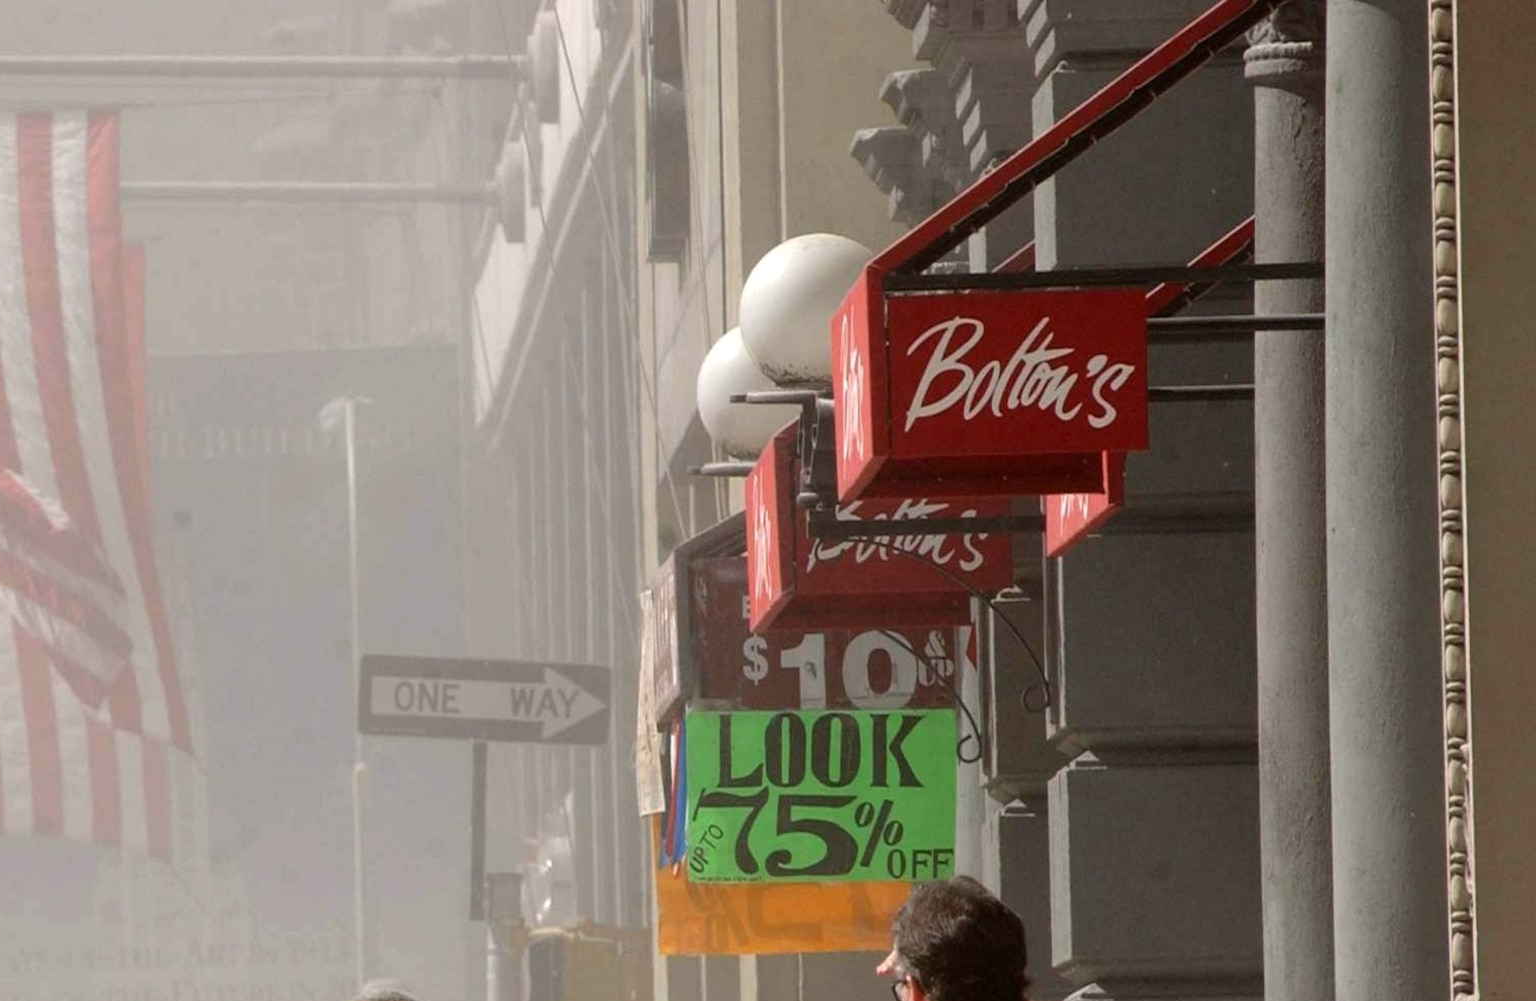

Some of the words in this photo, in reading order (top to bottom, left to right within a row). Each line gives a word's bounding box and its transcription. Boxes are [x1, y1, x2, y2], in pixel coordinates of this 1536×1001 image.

[905, 316, 1134, 433] Bolton's
[394, 681, 460, 714] ONE
[510, 686, 580, 719] WAY
[717, 711, 924, 789] LOOK
[692, 786, 904, 877] 75%
[886, 848, 955, 880] OFF
